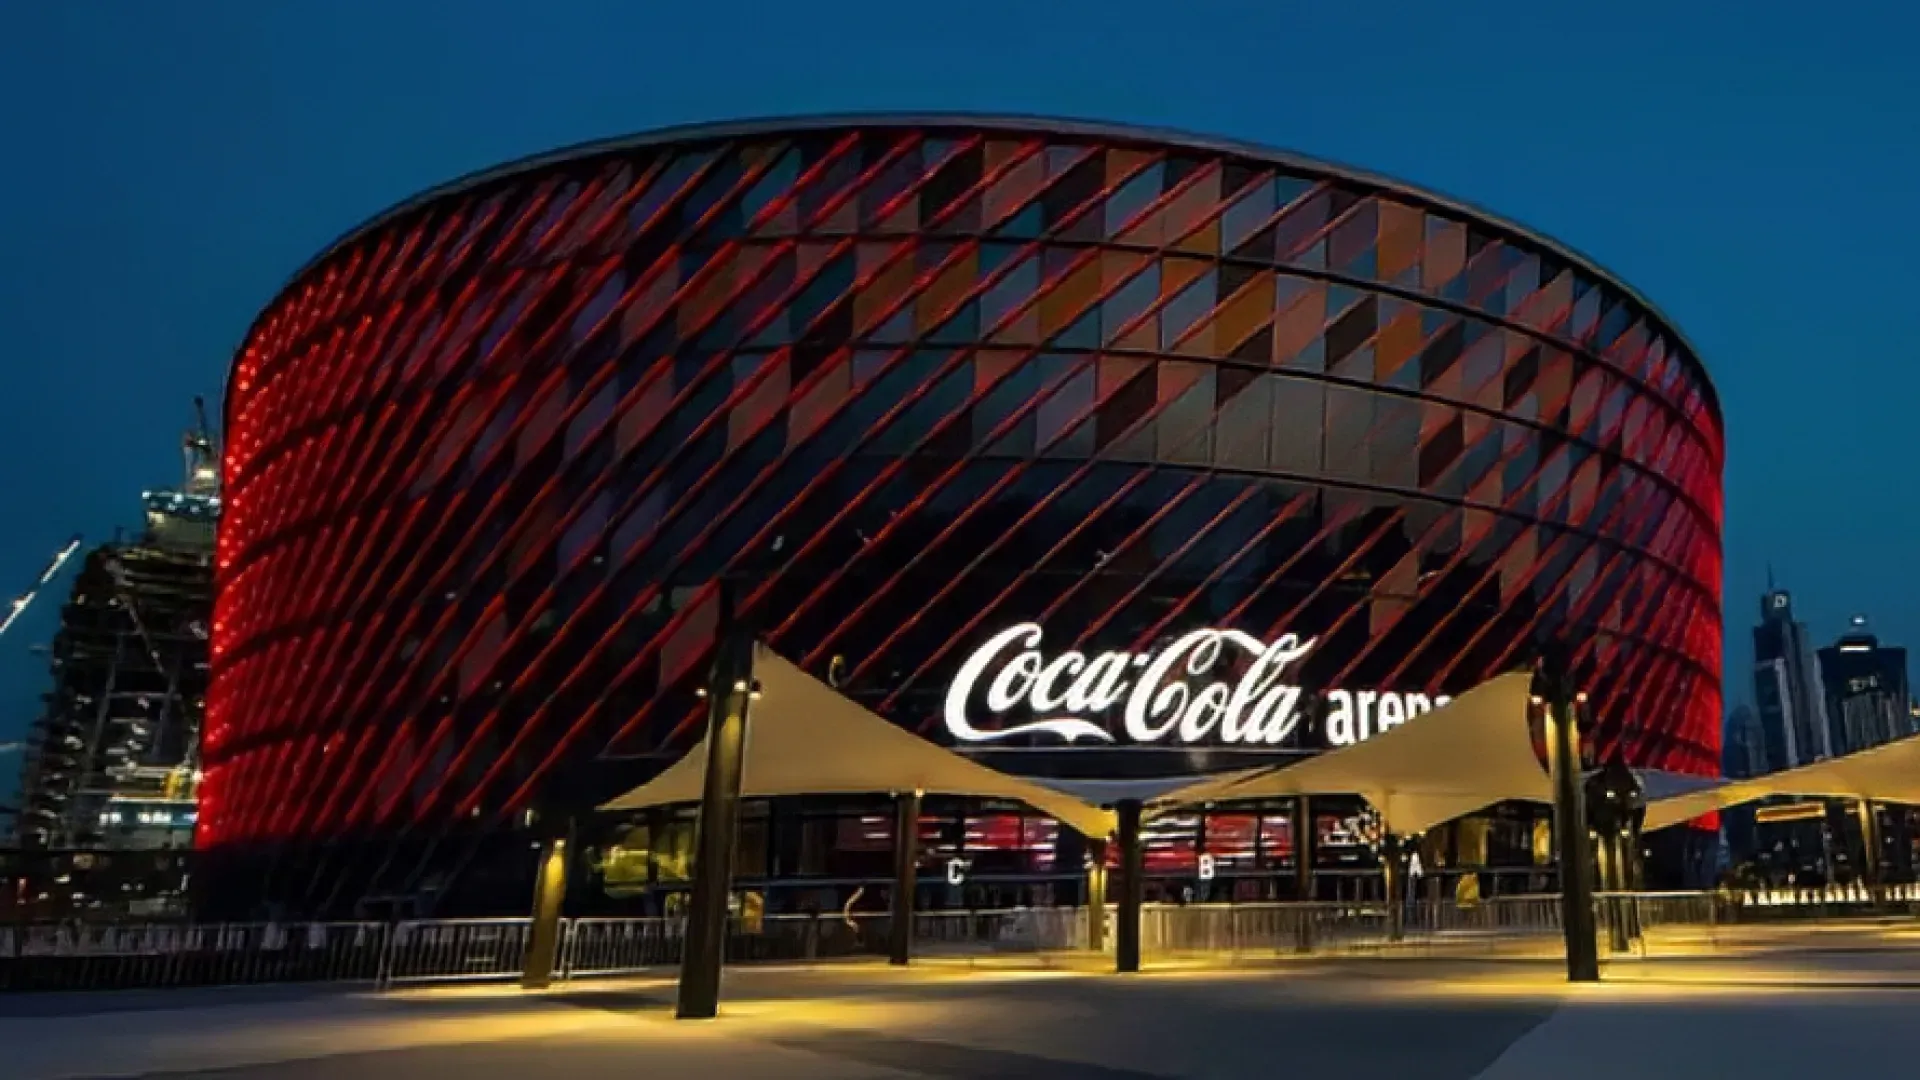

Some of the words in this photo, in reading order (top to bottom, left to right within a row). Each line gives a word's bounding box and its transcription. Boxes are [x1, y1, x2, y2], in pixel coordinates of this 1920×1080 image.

[945, 622, 1317, 743] Coca-Cola
[1325, 689, 1452, 746] aren
[947, 857, 965, 885] C
[1198, 853, 1215, 880] B
[1408, 851, 1424, 878] A
